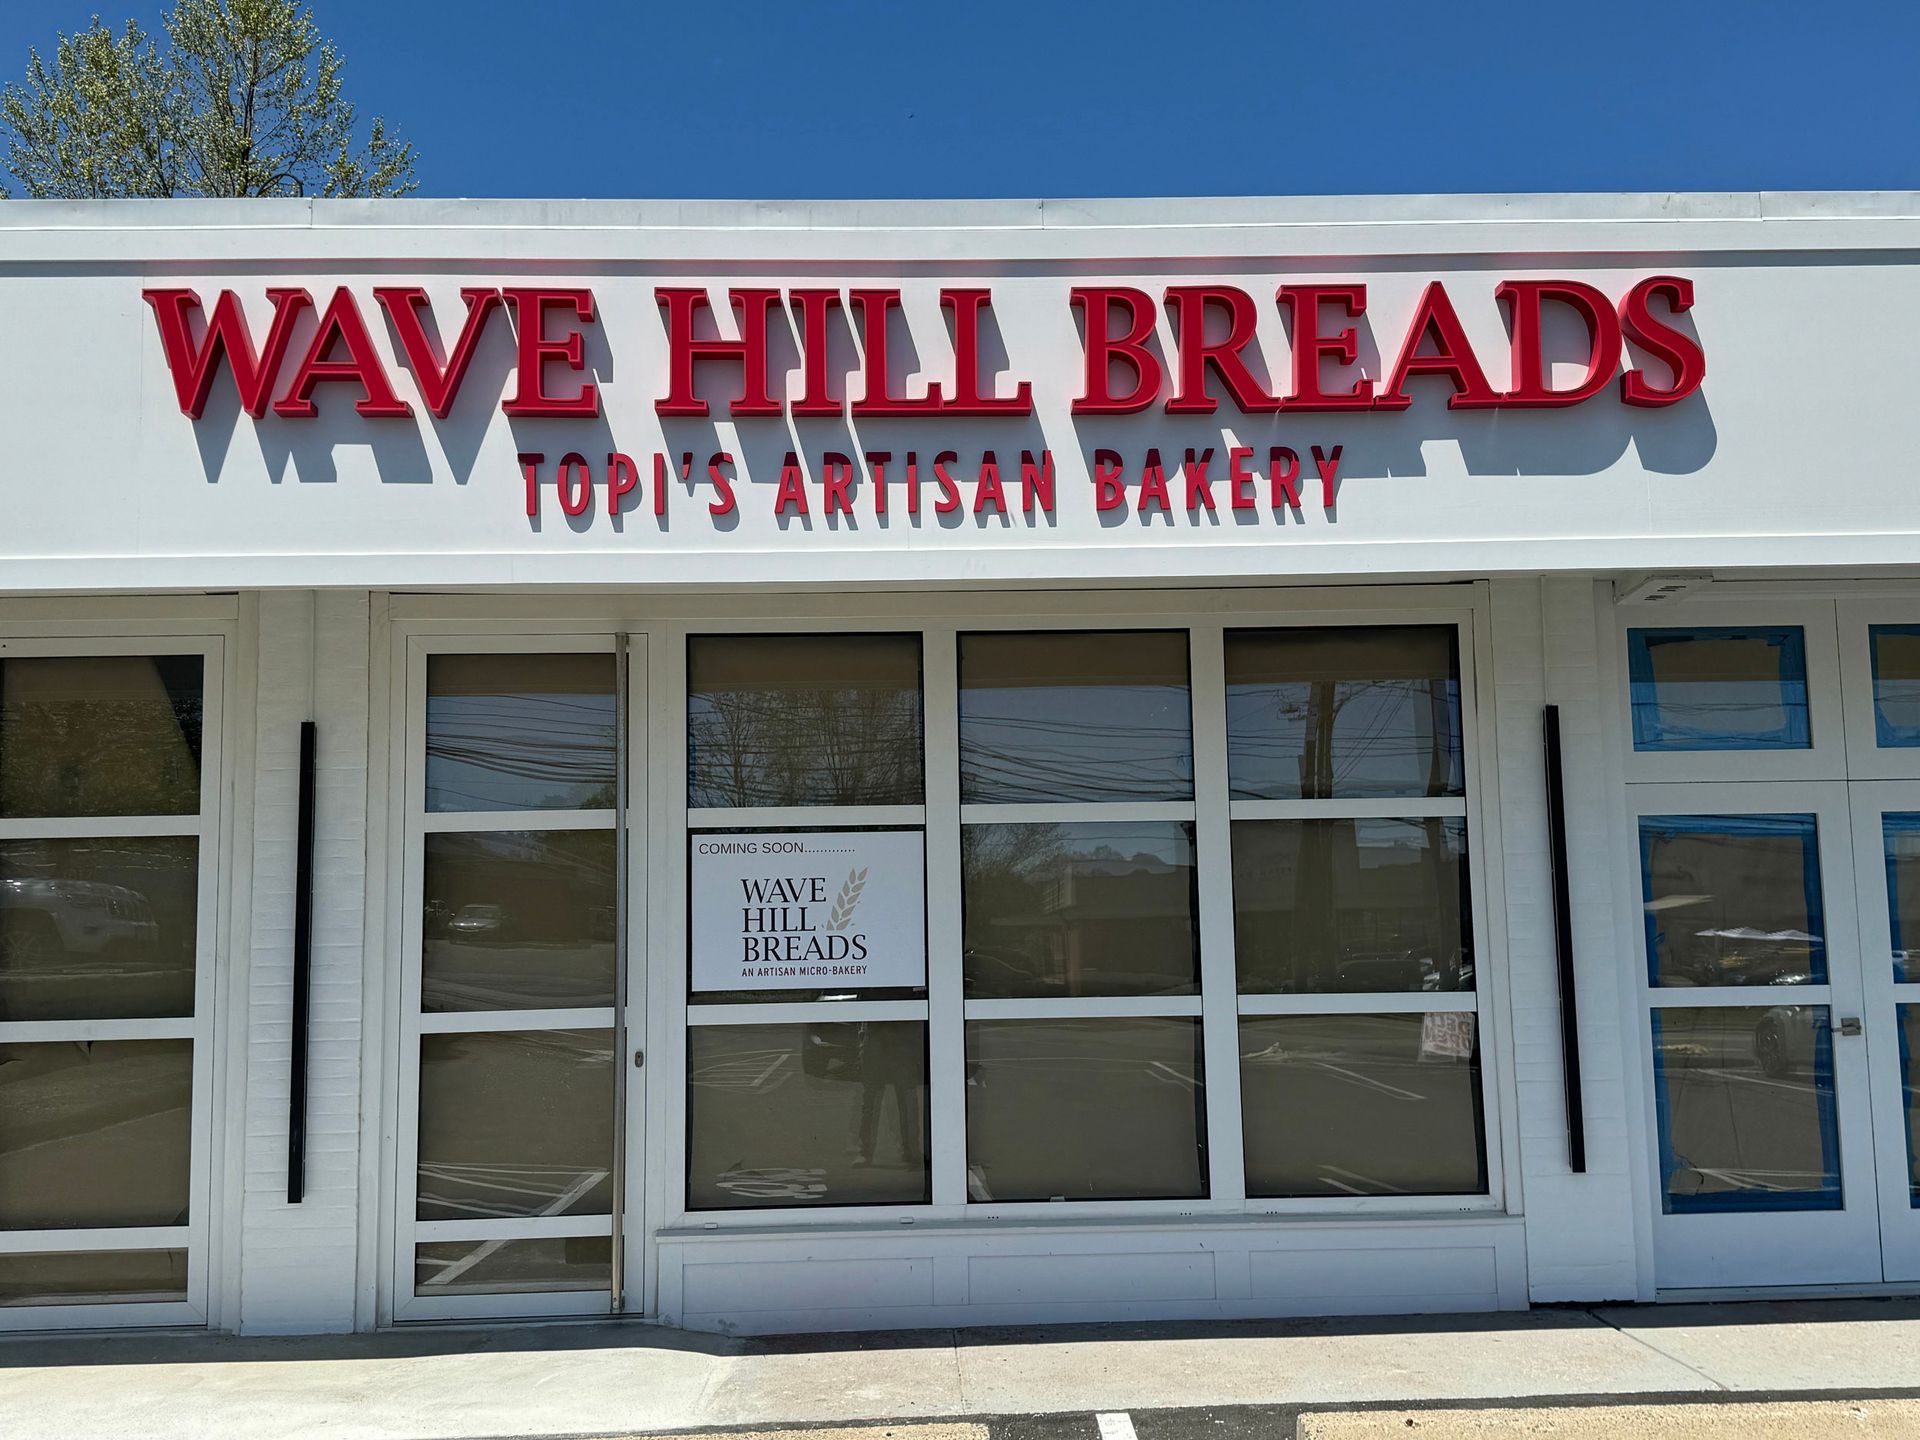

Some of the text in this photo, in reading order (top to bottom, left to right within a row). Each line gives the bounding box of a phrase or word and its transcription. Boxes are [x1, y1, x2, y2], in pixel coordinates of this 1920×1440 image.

[142, 275, 1706, 420] WAVE HILL BREADS
[518, 445, 1344, 517] TOPI'S ARTISAN BAKERY
[699, 842, 758, 855] COMING
[740, 877, 827, 904] WAVE
[742, 906, 816, 933] HILL
[742, 934, 868, 962] BREADS
[741, 964, 868, 977] AN ARTISAN MICRO-BAKERY
